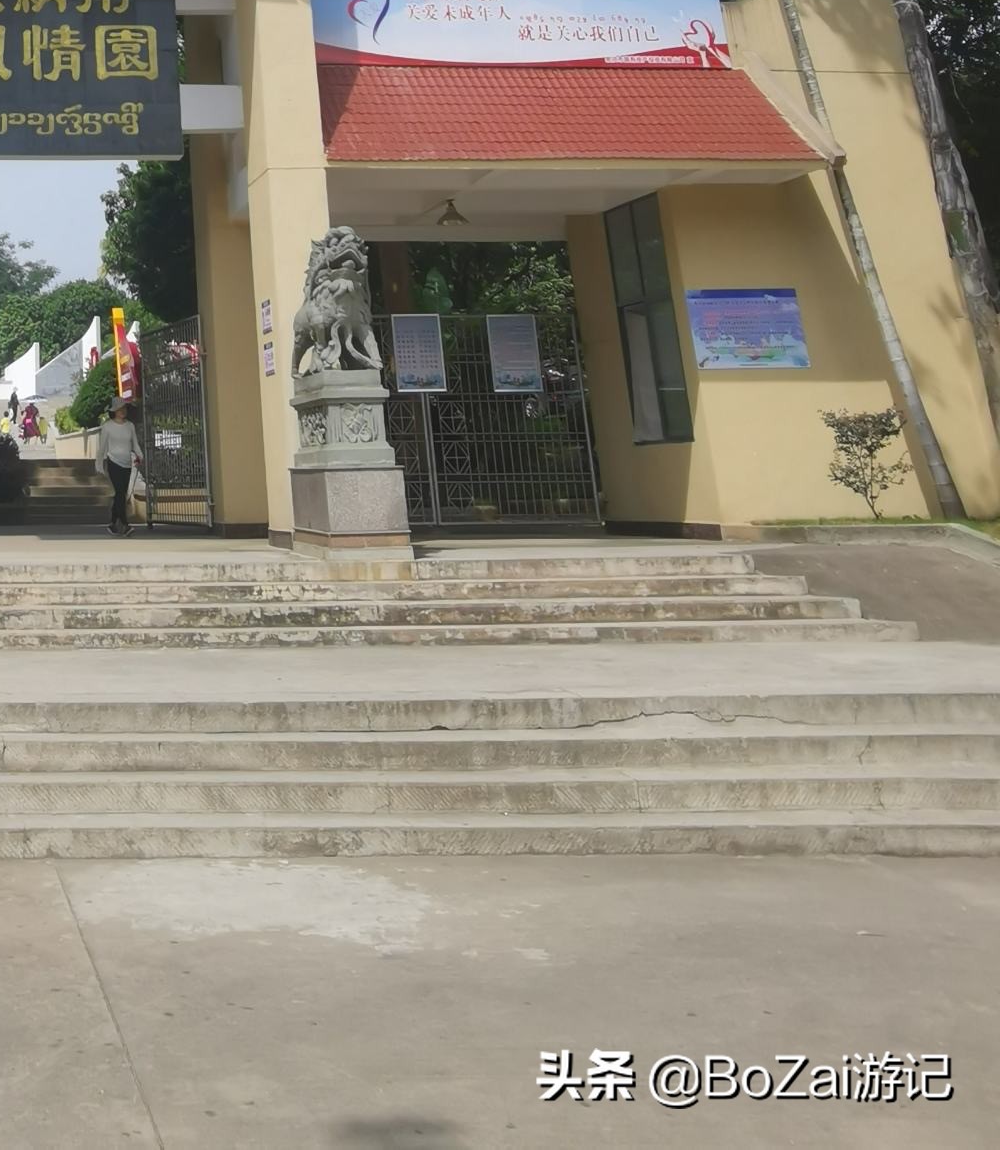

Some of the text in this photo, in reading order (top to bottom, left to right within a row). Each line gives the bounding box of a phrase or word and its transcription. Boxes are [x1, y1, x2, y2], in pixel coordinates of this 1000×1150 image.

[407, 4, 512, 21] 关爱未成年人
[518, 24, 660, 42] 就是关心我们自己
